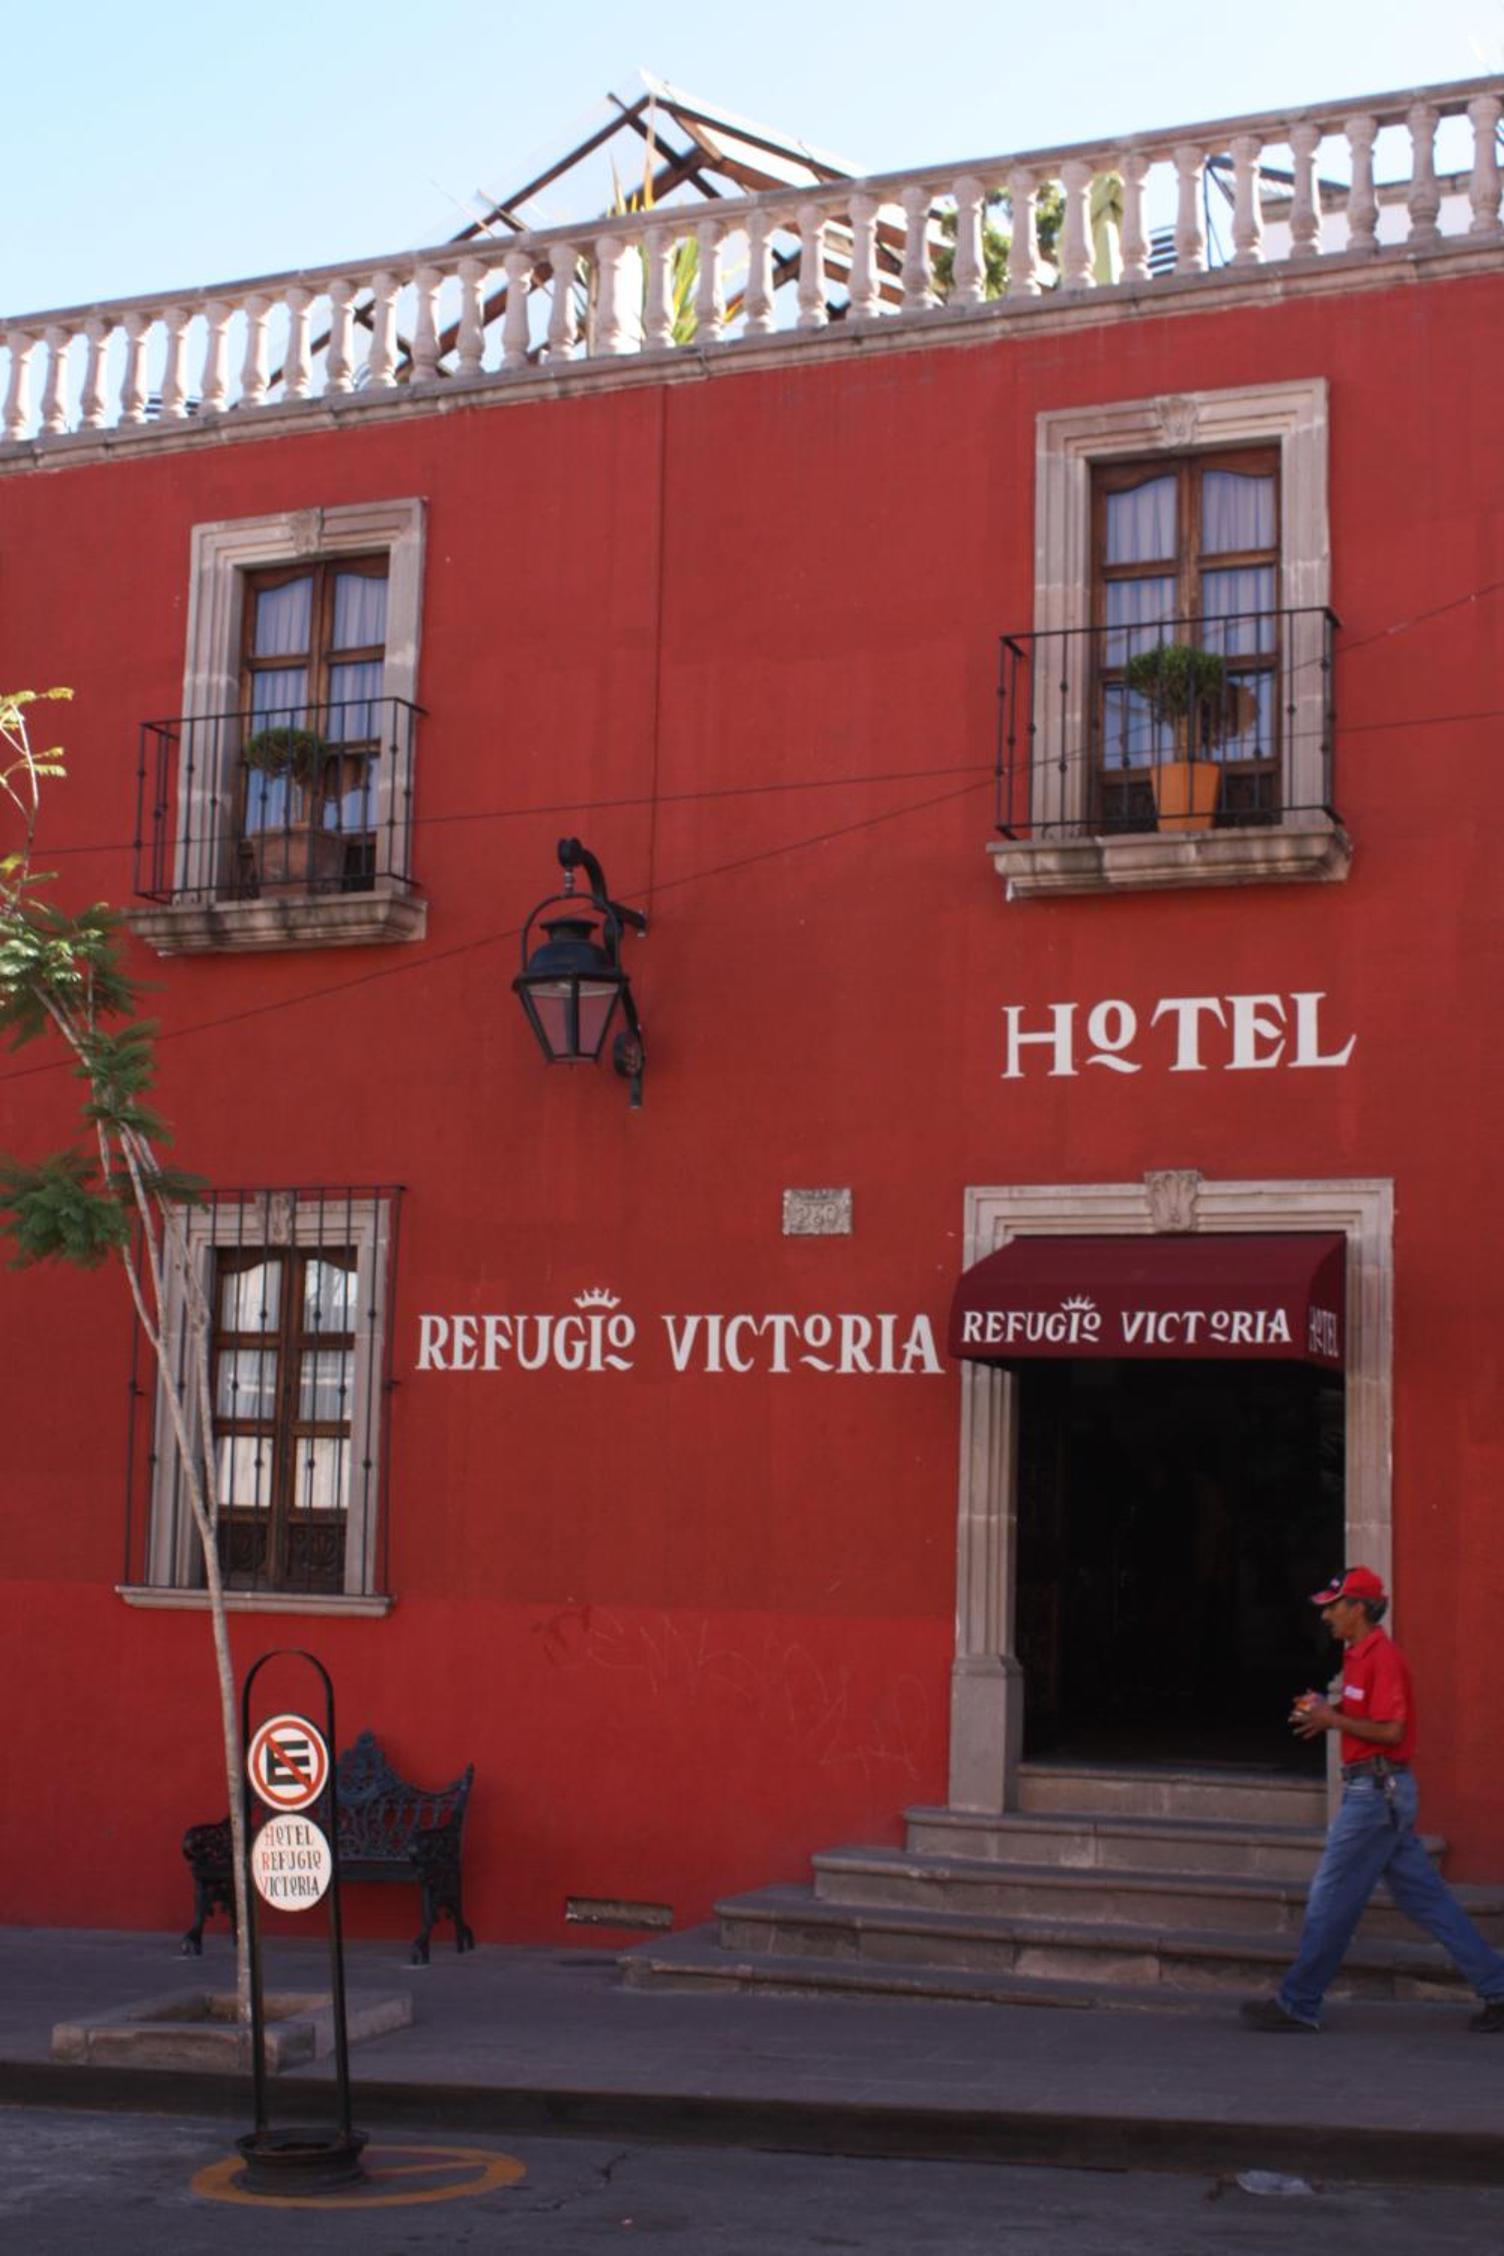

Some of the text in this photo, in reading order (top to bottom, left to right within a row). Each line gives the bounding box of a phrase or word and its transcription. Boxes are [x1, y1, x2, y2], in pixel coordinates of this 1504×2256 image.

[1001, 992, 1357, 1078] HOTEL
[415, 1313, 946, 1374] REFUGIO VICTORIA
[962, 1309, 1292, 1344] REFUGIO VICTORIA
[1308, 1306, 1339, 1357] HOTEL
[265, 1824, 313, 1846] HOTEL
[261, 1851, 322, 1871] REFUGIO
[258, 1875, 320, 1897] VICTORIA
